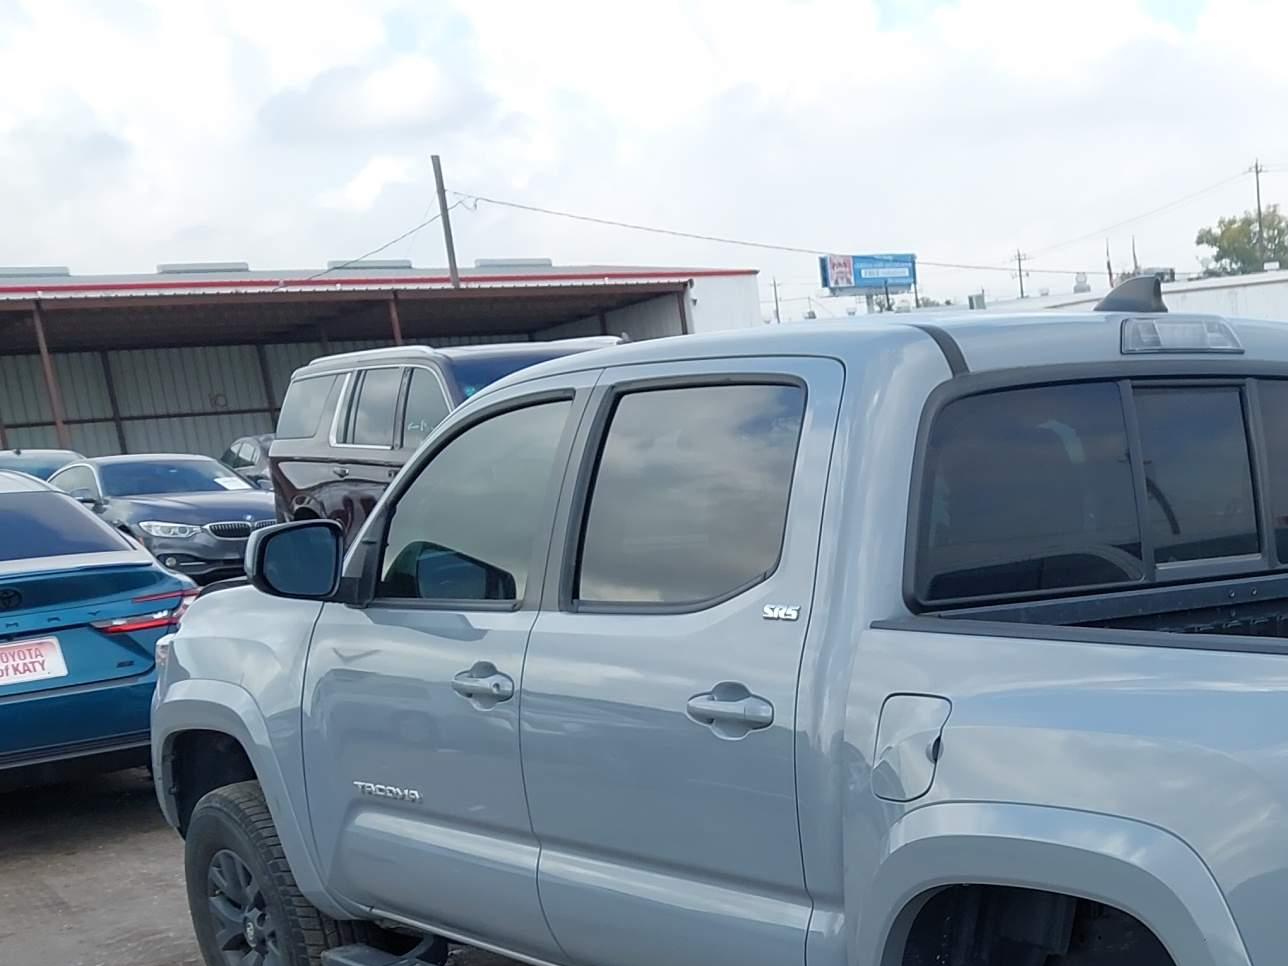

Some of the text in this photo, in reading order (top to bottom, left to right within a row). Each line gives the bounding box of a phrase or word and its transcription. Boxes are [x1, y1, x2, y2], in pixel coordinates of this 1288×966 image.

[762, 604, 801, 621] SR5
[0, 647, 44, 664] OYOTA
[11, 659, 46, 675] KATY
[353, 780, 421, 801] TACOMA
